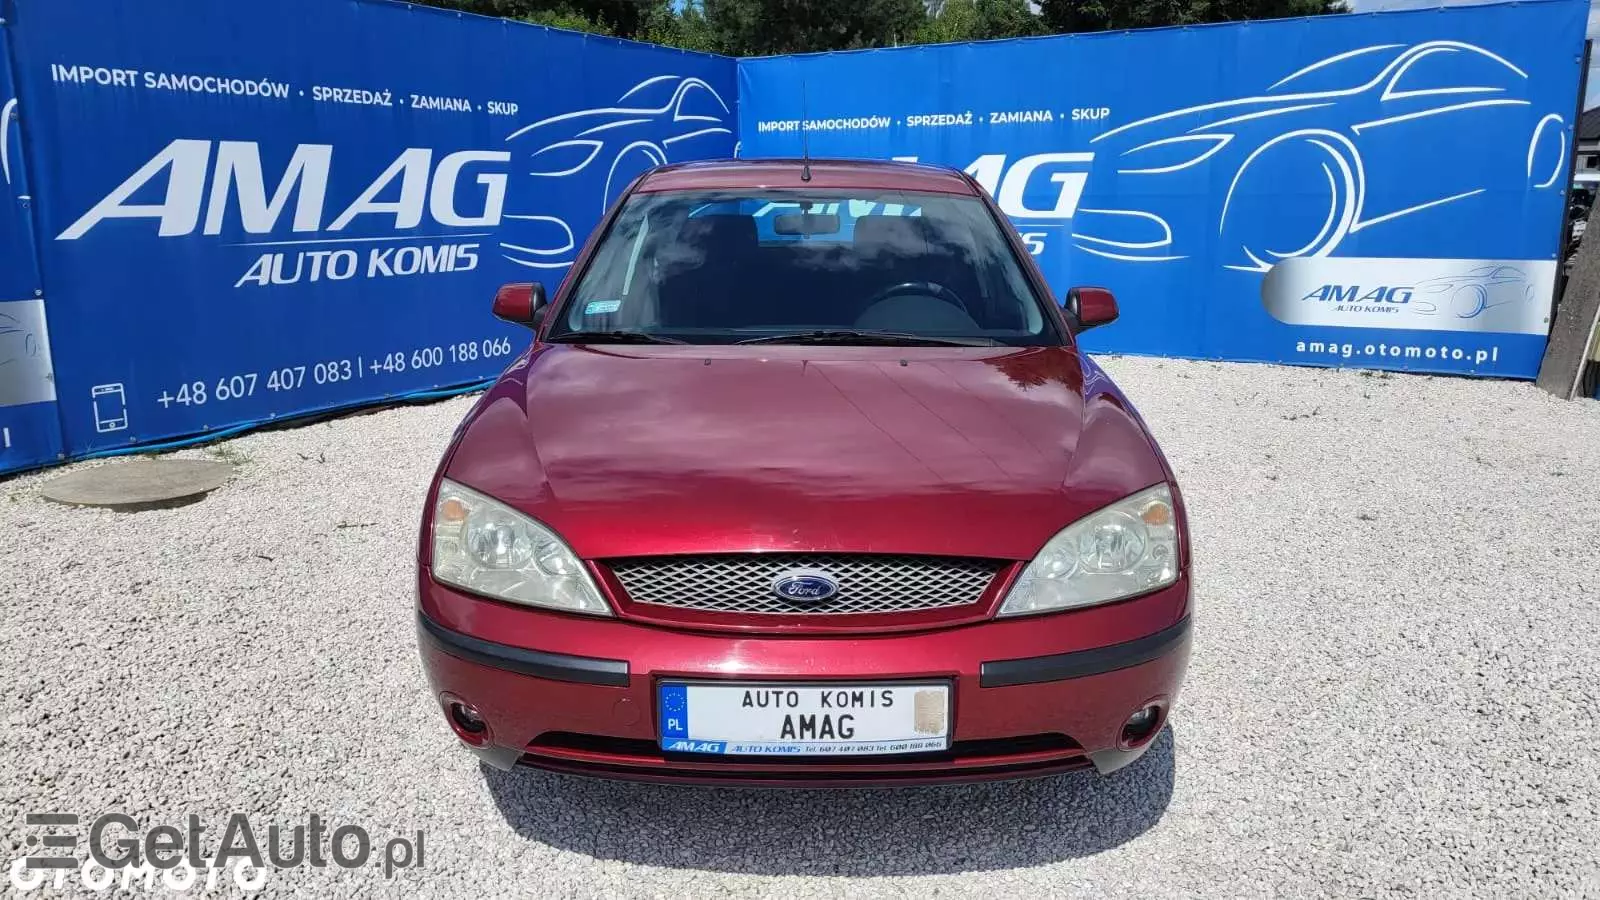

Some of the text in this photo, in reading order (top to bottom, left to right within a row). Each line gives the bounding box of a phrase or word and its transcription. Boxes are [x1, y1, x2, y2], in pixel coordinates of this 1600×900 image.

[51, 63, 519, 116] IMPORT SAMOCHODÓW SPRZEDAŻ ZAMIANA SKUP
[758, 107, 1110, 132] IMPORT SAMOCHODÓW SPRZEDAŻ ZAMIANA SKUP
[234, 243, 480, 287] AUTO KOMIS
[1364, 305, 1400, 314] KOMIS
[1296, 340, 1498, 364] amag.otomoto.pl
[157, 381, 207, 409] +48
[215, 373, 258, 401] 607
[267, 366, 306, 392] 407
[314, 359, 352, 385] 083
[369, 352, 406, 377] +48
[411, 346, 444, 369] 600
[450, 341, 477, 364] 188
[482, 336, 512, 359] 066
[788, 582, 820, 596] Ford
[742, 690, 894, 709] AUTO KOMIS
[668, 718, 684, 731] PL
[781, 714, 854, 740] AMAG
[732, 744, 763, 753] AUTO
[764, 744, 801, 754] KOMIS
